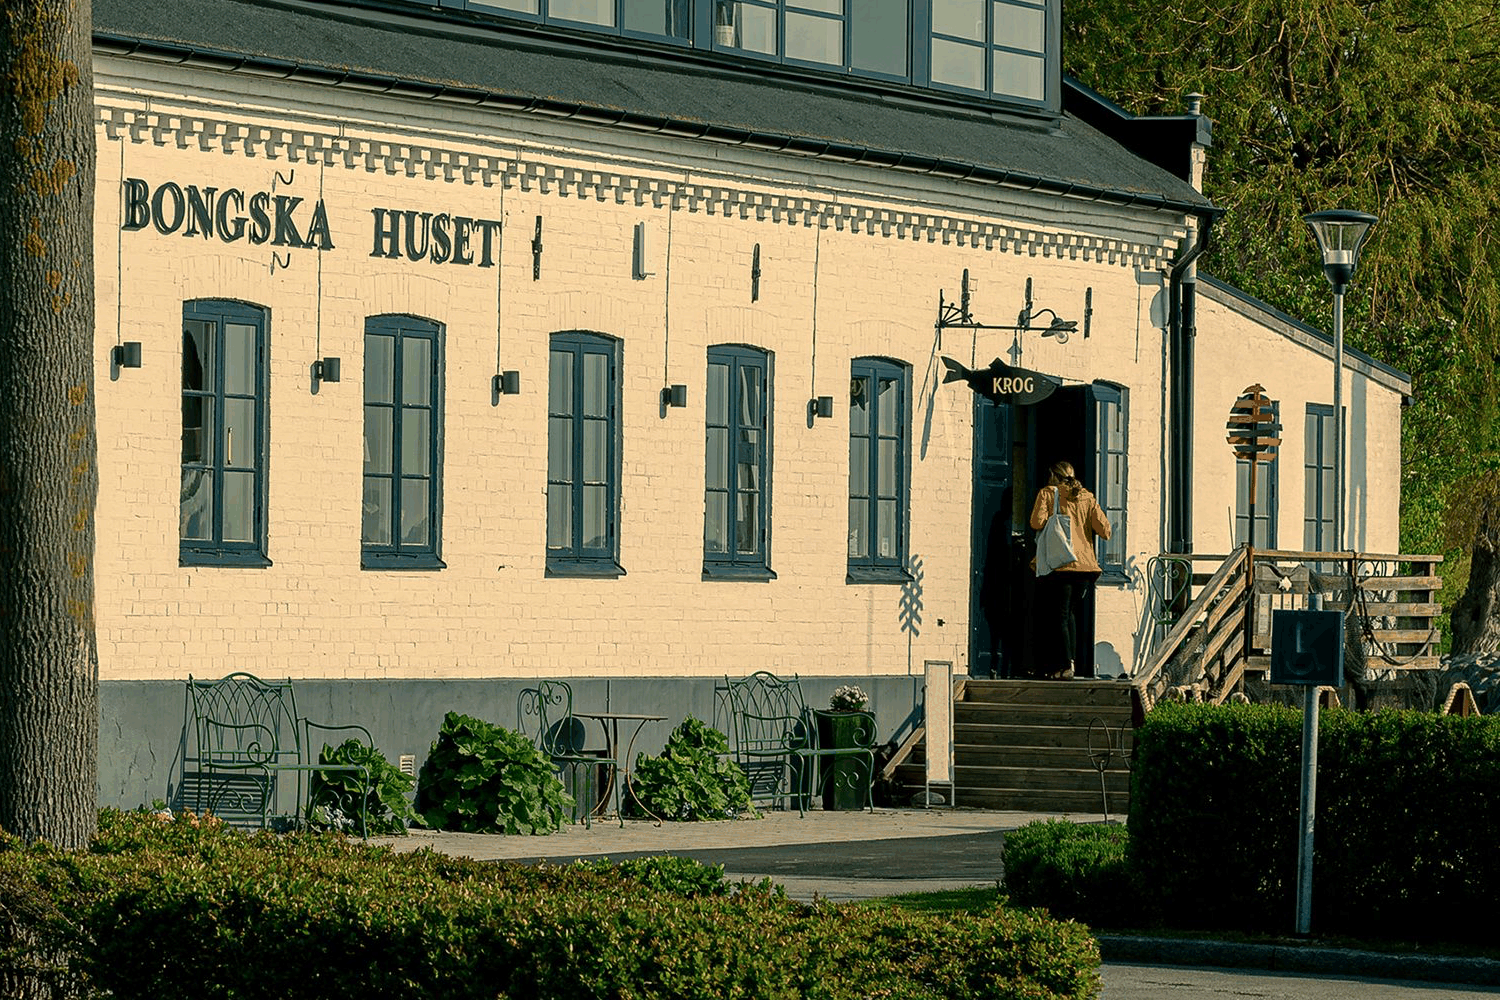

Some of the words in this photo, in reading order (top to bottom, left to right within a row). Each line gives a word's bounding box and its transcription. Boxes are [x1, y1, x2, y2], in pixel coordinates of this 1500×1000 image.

[122, 177, 335, 251] BONGSKA
[369, 207, 503, 268] HUSET
[993, 376, 1035, 395] KROG
